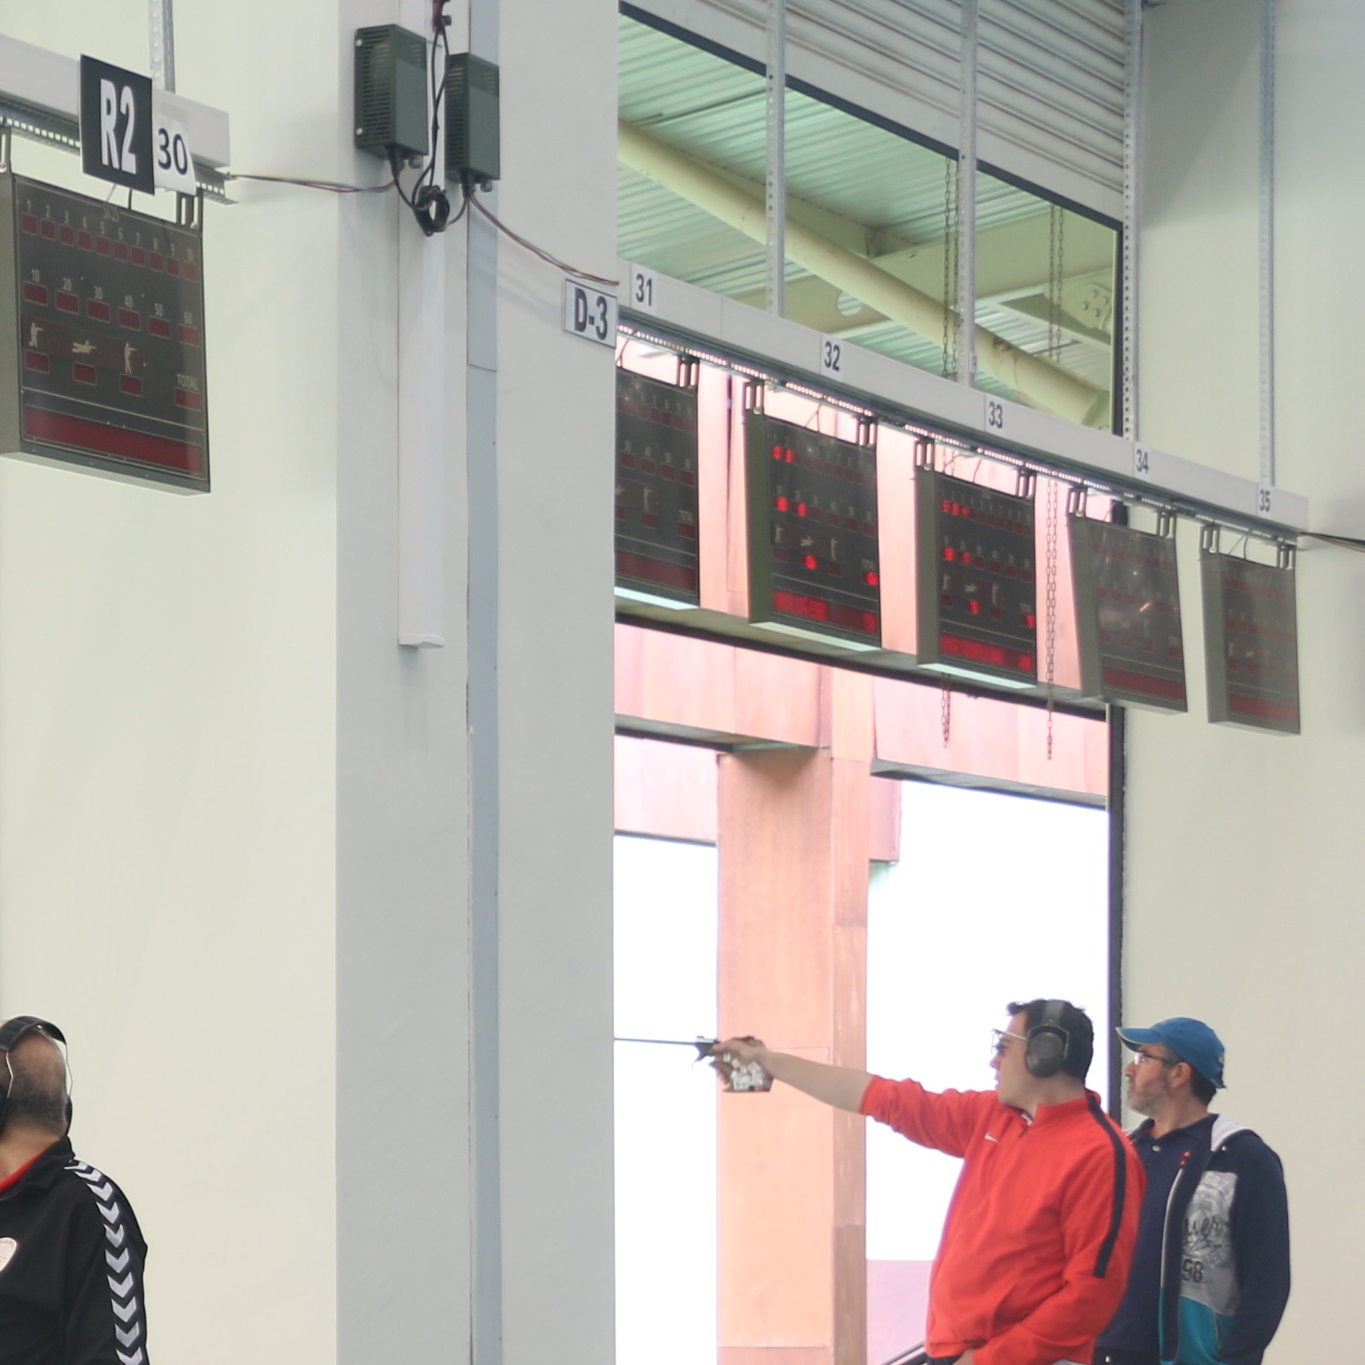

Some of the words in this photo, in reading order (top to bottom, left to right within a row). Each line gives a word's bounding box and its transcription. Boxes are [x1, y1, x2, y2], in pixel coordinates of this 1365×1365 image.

[100, 78, 138, 176] R2
[157, 127, 188, 176] 30
[46, 205, 51, 218] 2
[64, 211, 69, 224] 3
[82, 216, 87, 228] 4
[32, 269, 40, 282] 10
[63, 277, 72, 291] 20
[94, 286, 103, 300] 30
[125, 295, 133, 308] 40
[155, 303, 163, 317] 50
[635, 273, 652, 306] 31
[574, 287, 608, 340] D-3
[824, 341, 840, 372] 32
[177, 374, 198, 390] TOTAL
[988, 401, 1003, 429] 33
[1136, 450, 1149, 474] 34
[1260, 489, 1270, 512] 35
